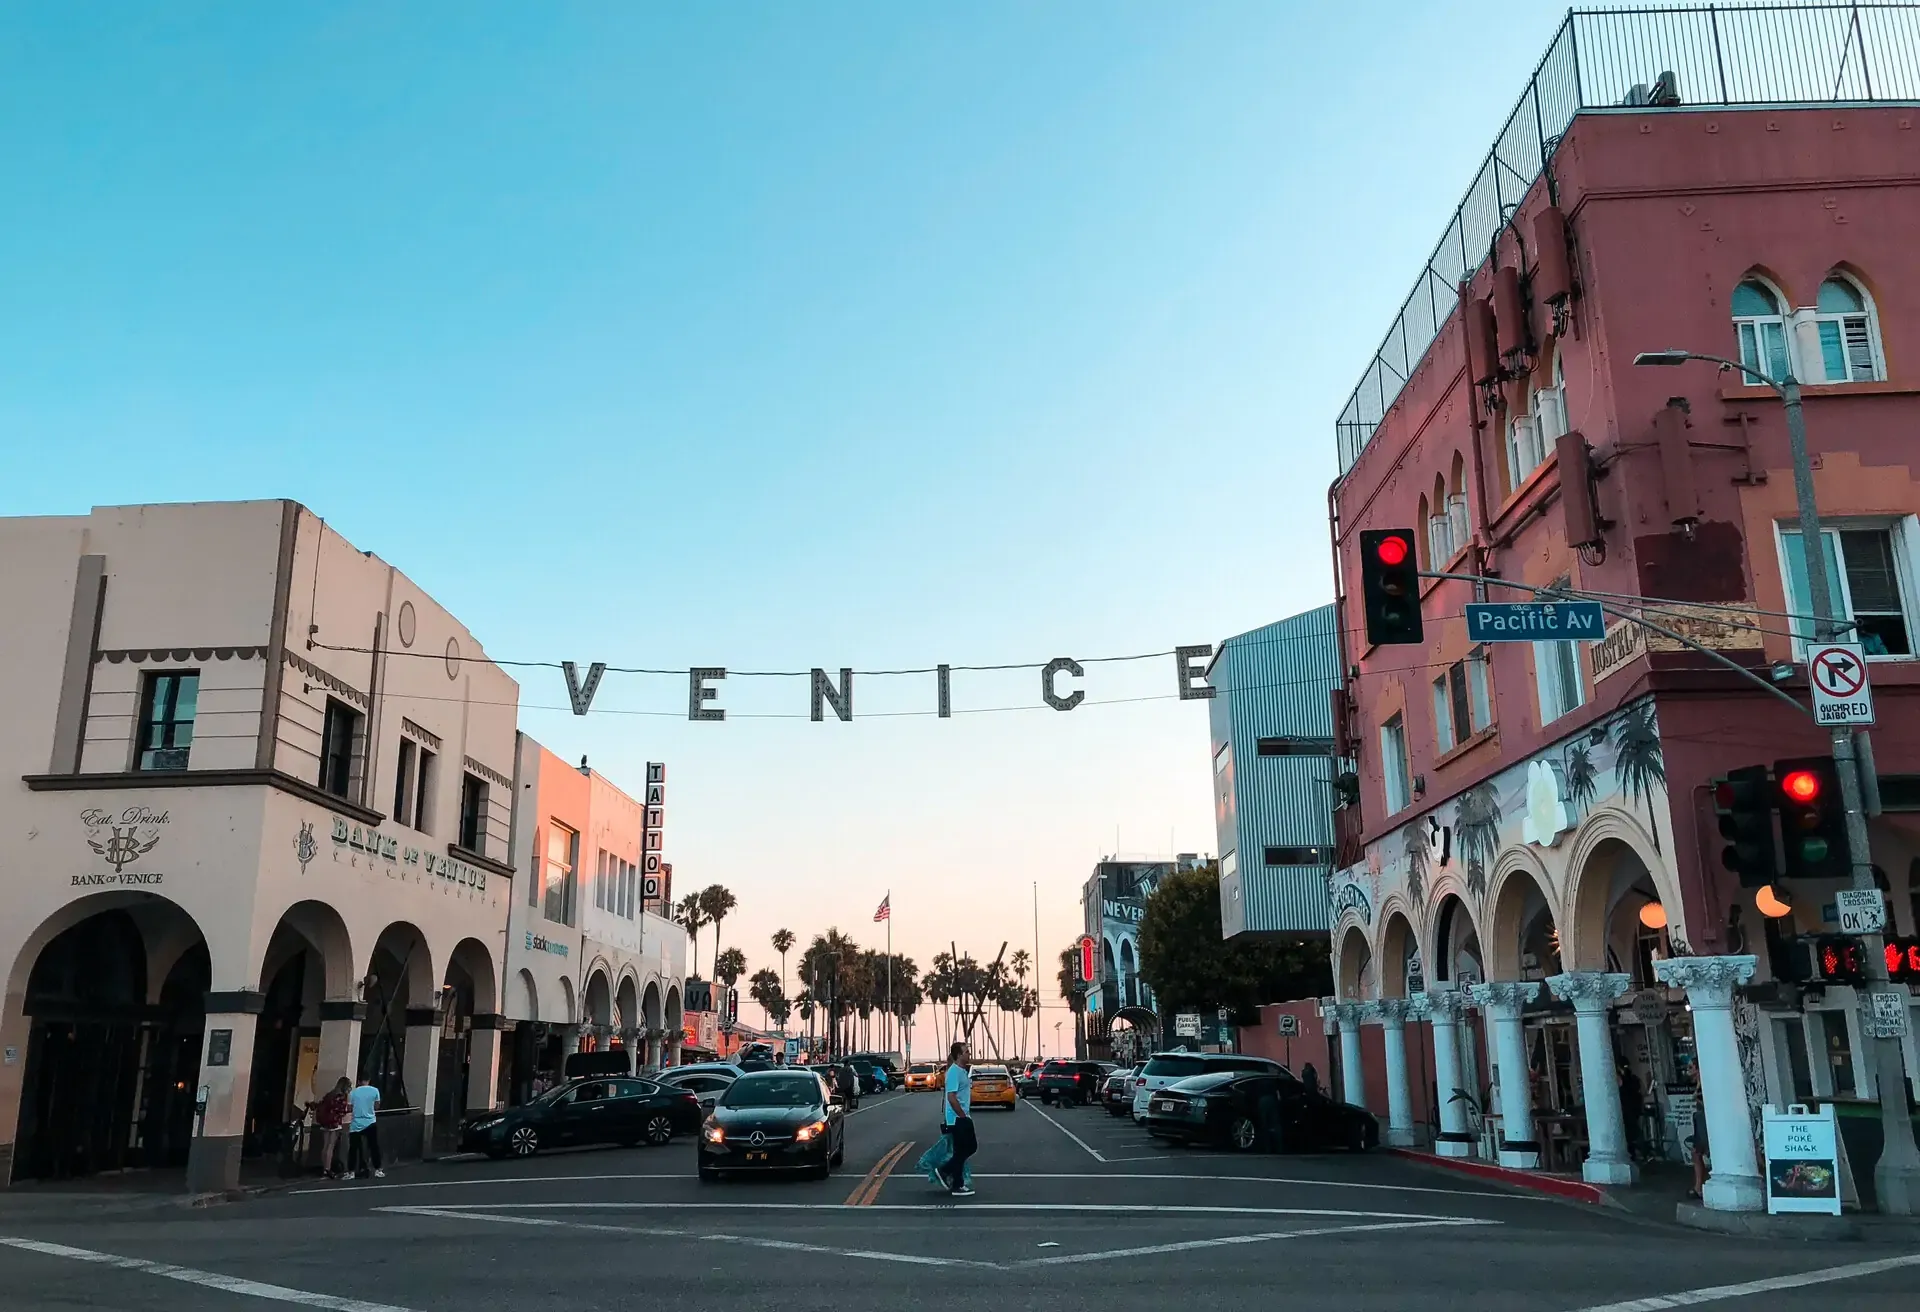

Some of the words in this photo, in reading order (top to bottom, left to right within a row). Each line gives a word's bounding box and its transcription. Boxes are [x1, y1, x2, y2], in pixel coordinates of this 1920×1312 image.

[1478, 610, 1558, 631] Pacific
[1566, 610, 1593, 630] Av
[562, 643, 1217, 721] VENICE
[1843, 703, 1868, 716] RED
[645, 764, 661, 895] TATTOO
[332, 816, 397, 861] BANK
[424, 850, 487, 890] VENICE
[71, 874, 105, 886] BANK
[119, 873, 163, 885] VENICE
[1842, 890, 1876, 899] DIAGONAL
[1843, 898, 1877, 907] CROSSING
[1103, 899, 1144, 921] NEVER
[1843, 912, 1861, 929] OK
